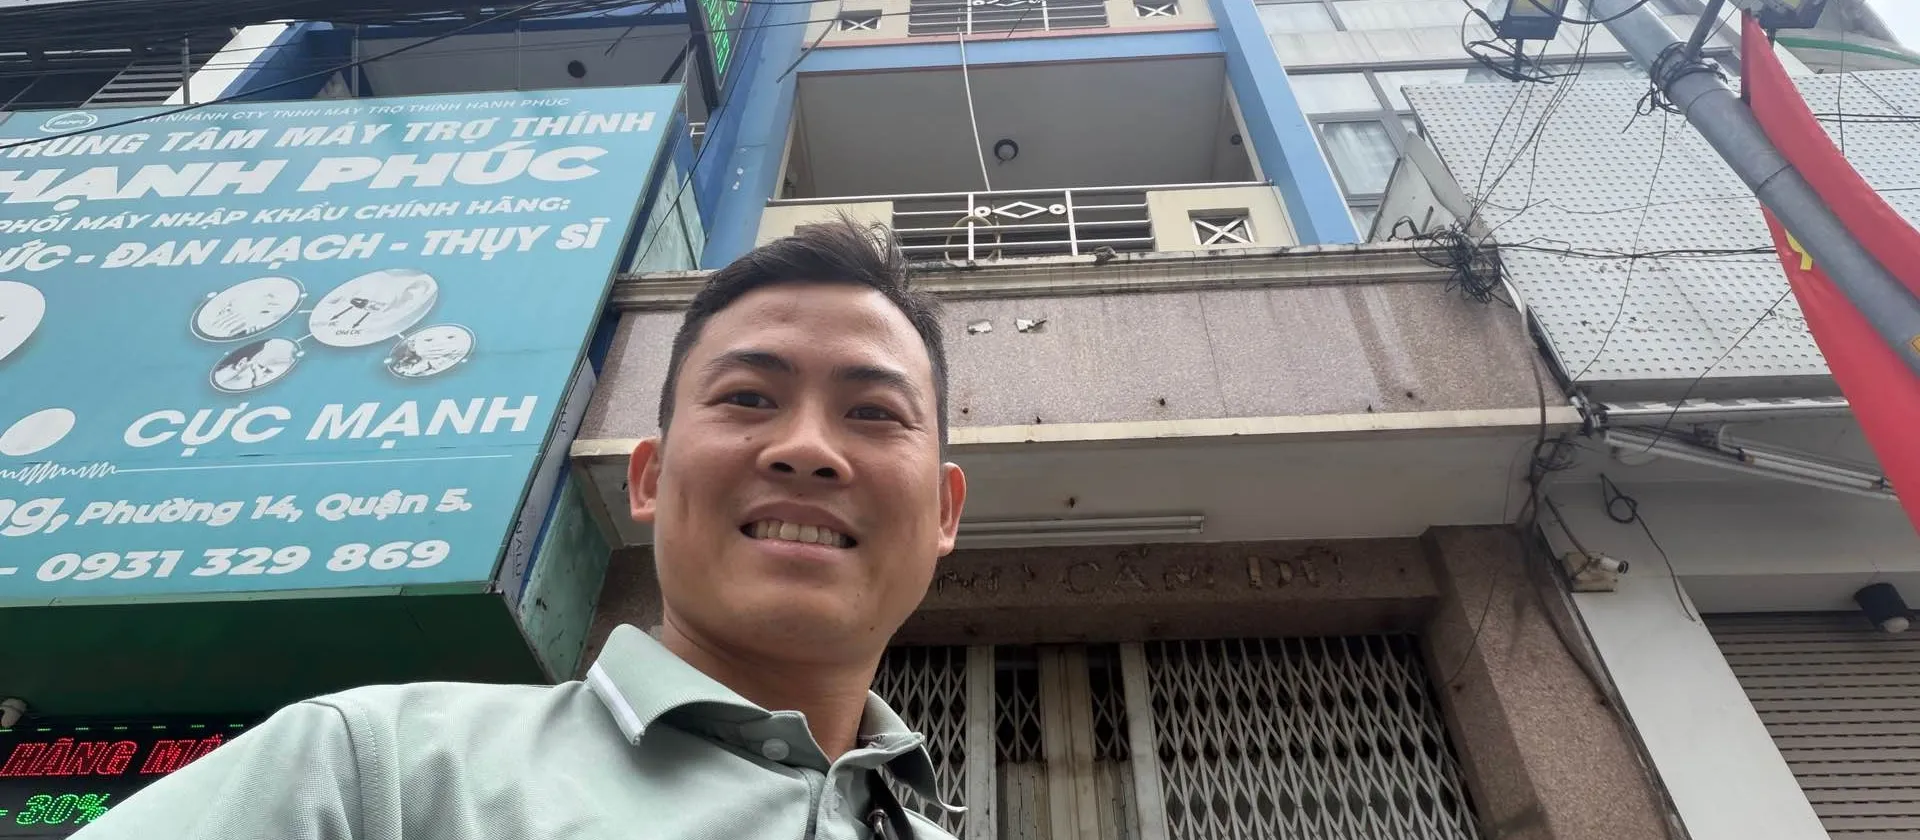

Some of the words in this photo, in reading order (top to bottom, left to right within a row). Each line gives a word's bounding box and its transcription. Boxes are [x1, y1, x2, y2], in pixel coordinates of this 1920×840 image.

[0, 133, 150, 158] TRUNG
[159, 127, 268, 151] TÂM
[275, 121, 392, 148] MÁY
[402, 117, 500, 144] TRỢ
[510, 111, 657, 138] THÍNH
[233, 110, 267, 120] CTY
[0, 159, 289, 212] HẠNH
[296, 140, 609, 192] PHÚC
[72, 211, 151, 232] MÁY
[151, 207, 248, 230] NHẬP
[251, 201, 350, 224] KHẨU
[354, 200, 461, 220] CHÍNH
[465, 196, 572, 216] HÃNG:
[100, 239, 221, 269] ĐAN
[220, 232, 385, 270] MẠCH
[420, 225, 551, 261] THỤY
[555, 217, 611, 250] SĨ
[124, 402, 291, 457] CỰC
[305, 395, 538, 449] MẠNH
[75, 498, 245, 527] Phường
[251, 495, 304, 523] 14,
[315, 489, 429, 522] Quận
[435, 488, 472, 513] 5.
[36, 550, 184, 582] 0931
[190, 545, 311, 577] 329
[326, 539, 450, 572] 869
[0, 737, 137, 777] HÃNG
[16, 793, 111, 825] 30%
